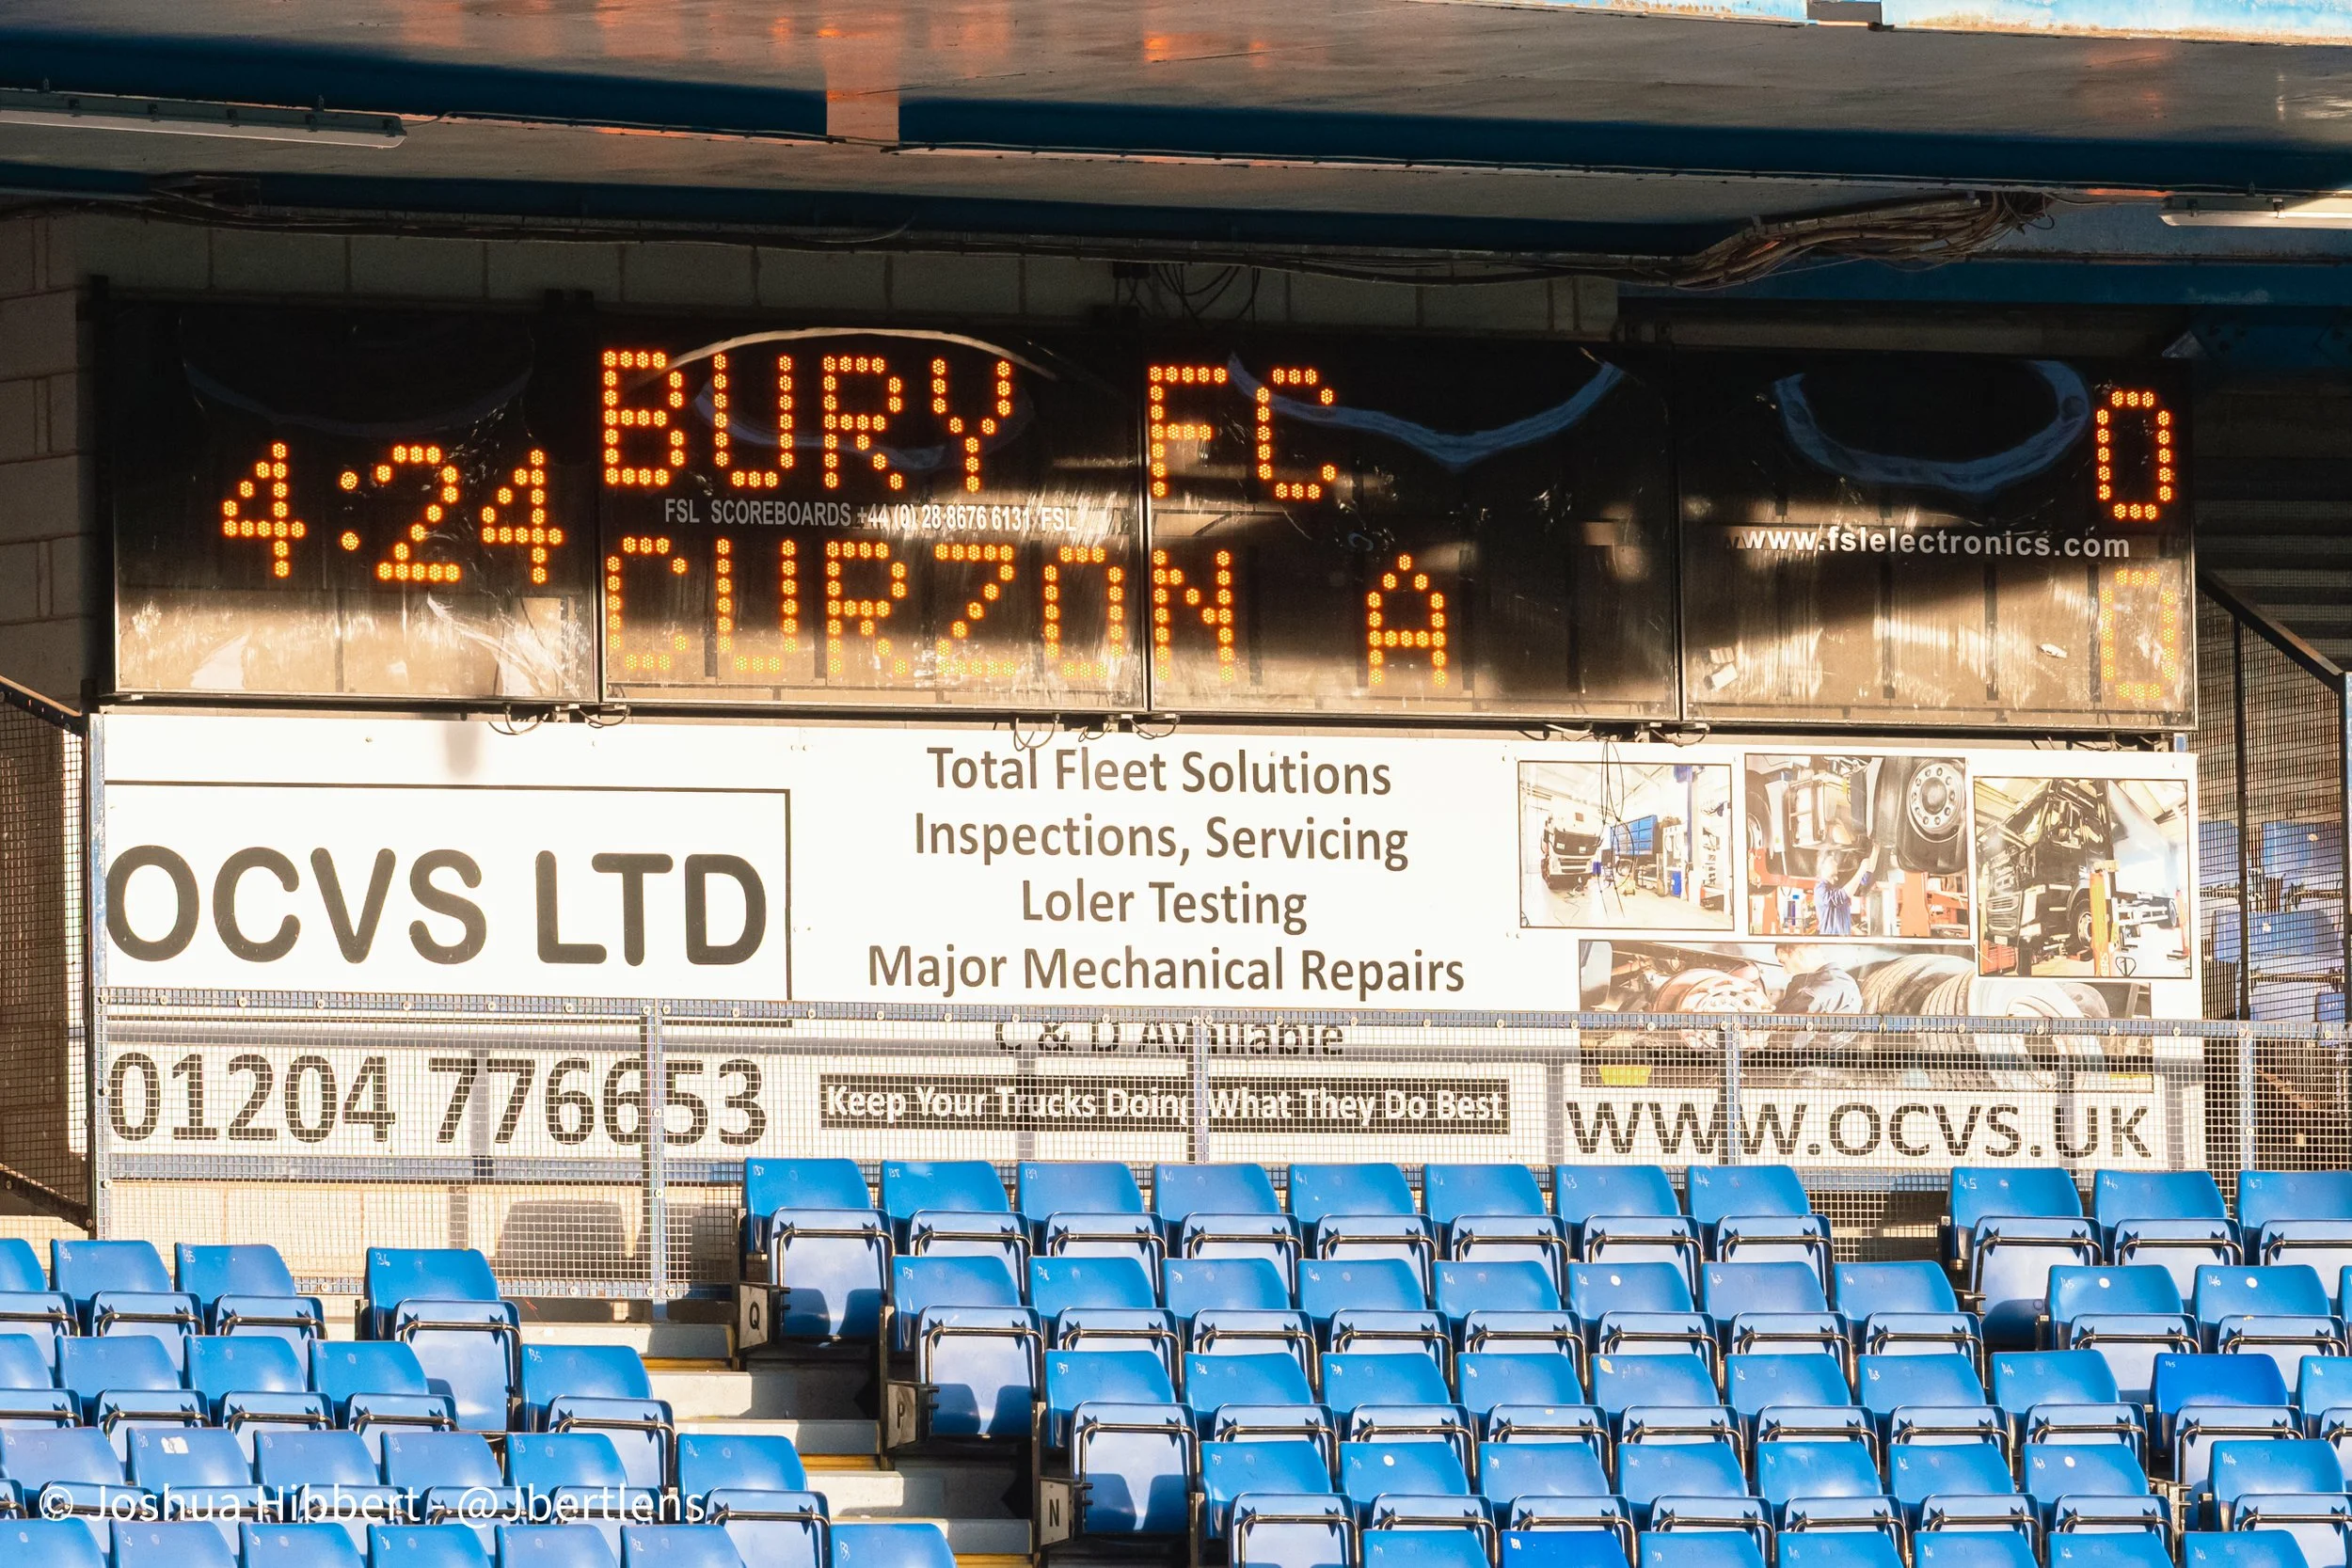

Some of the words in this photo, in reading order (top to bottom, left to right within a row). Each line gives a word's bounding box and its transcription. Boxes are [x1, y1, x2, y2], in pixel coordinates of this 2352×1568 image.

[603, 349, 1012, 494] BURY
[1149, 367, 1336, 500] FC
[2096, 390, 2173, 520] 0
[222, 441, 564, 584] 4:24
[665, 499, 699, 524] FSL
[711, 499, 851, 527] SCOREBOARDS
[857, 503, 889, 529] +44
[894, 503, 916, 531] (0)
[922, 504, 941, 530] 28
[946, 504, 987, 530] 8676
[992, 505, 1030, 531] 6131
[1041, 506, 1076, 531] FSL
[1741, 526, 2130, 558] www.fslelectronics.com
[606, 537, 1233, 683] CURZON
[1367, 553, 1447, 687] A
[928, 747, 1039, 788] Total
[1057, 748, 1166, 790] Fleet
[1184, 750, 1391, 795] Solutions
[917, 814, 1188, 865] Inspections,
[1207, 816, 1407, 871] Servicing
[105, 846, 487, 965] OCVS
[535, 850, 767, 966] LTD
[1024, 879, 1134, 921] Loler
[1150, 881, 1306, 935] Testing
[870, 944, 1006, 997] Major
[1025, 946, 1282, 990] Mechanical
[1303, 950, 1463, 1001] Repairs
[109, 1053, 396, 1145] 01204
[427, 1057, 767, 1148] 776653
[828, 1085, 906, 1123] Keep
[914, 1085, 987, 1117] Your
[994, 1085, 1096, 1118] Trucks
[1207, 1086, 1291, 1118] What
[1299, 1086, 1375, 1127] They
[1386, 1089, 1427, 1119] Do
[1438, 1089, 1502, 1120] Best
[1565, 1101, 2152, 1159] WWW.OCVS.UK
[1959, 1174, 1977, 1189] 145
[748, 1301, 760, 1330] Q
[897, 1403, 905, 1429] P
[1049, 1498, 1060, 1528] N
